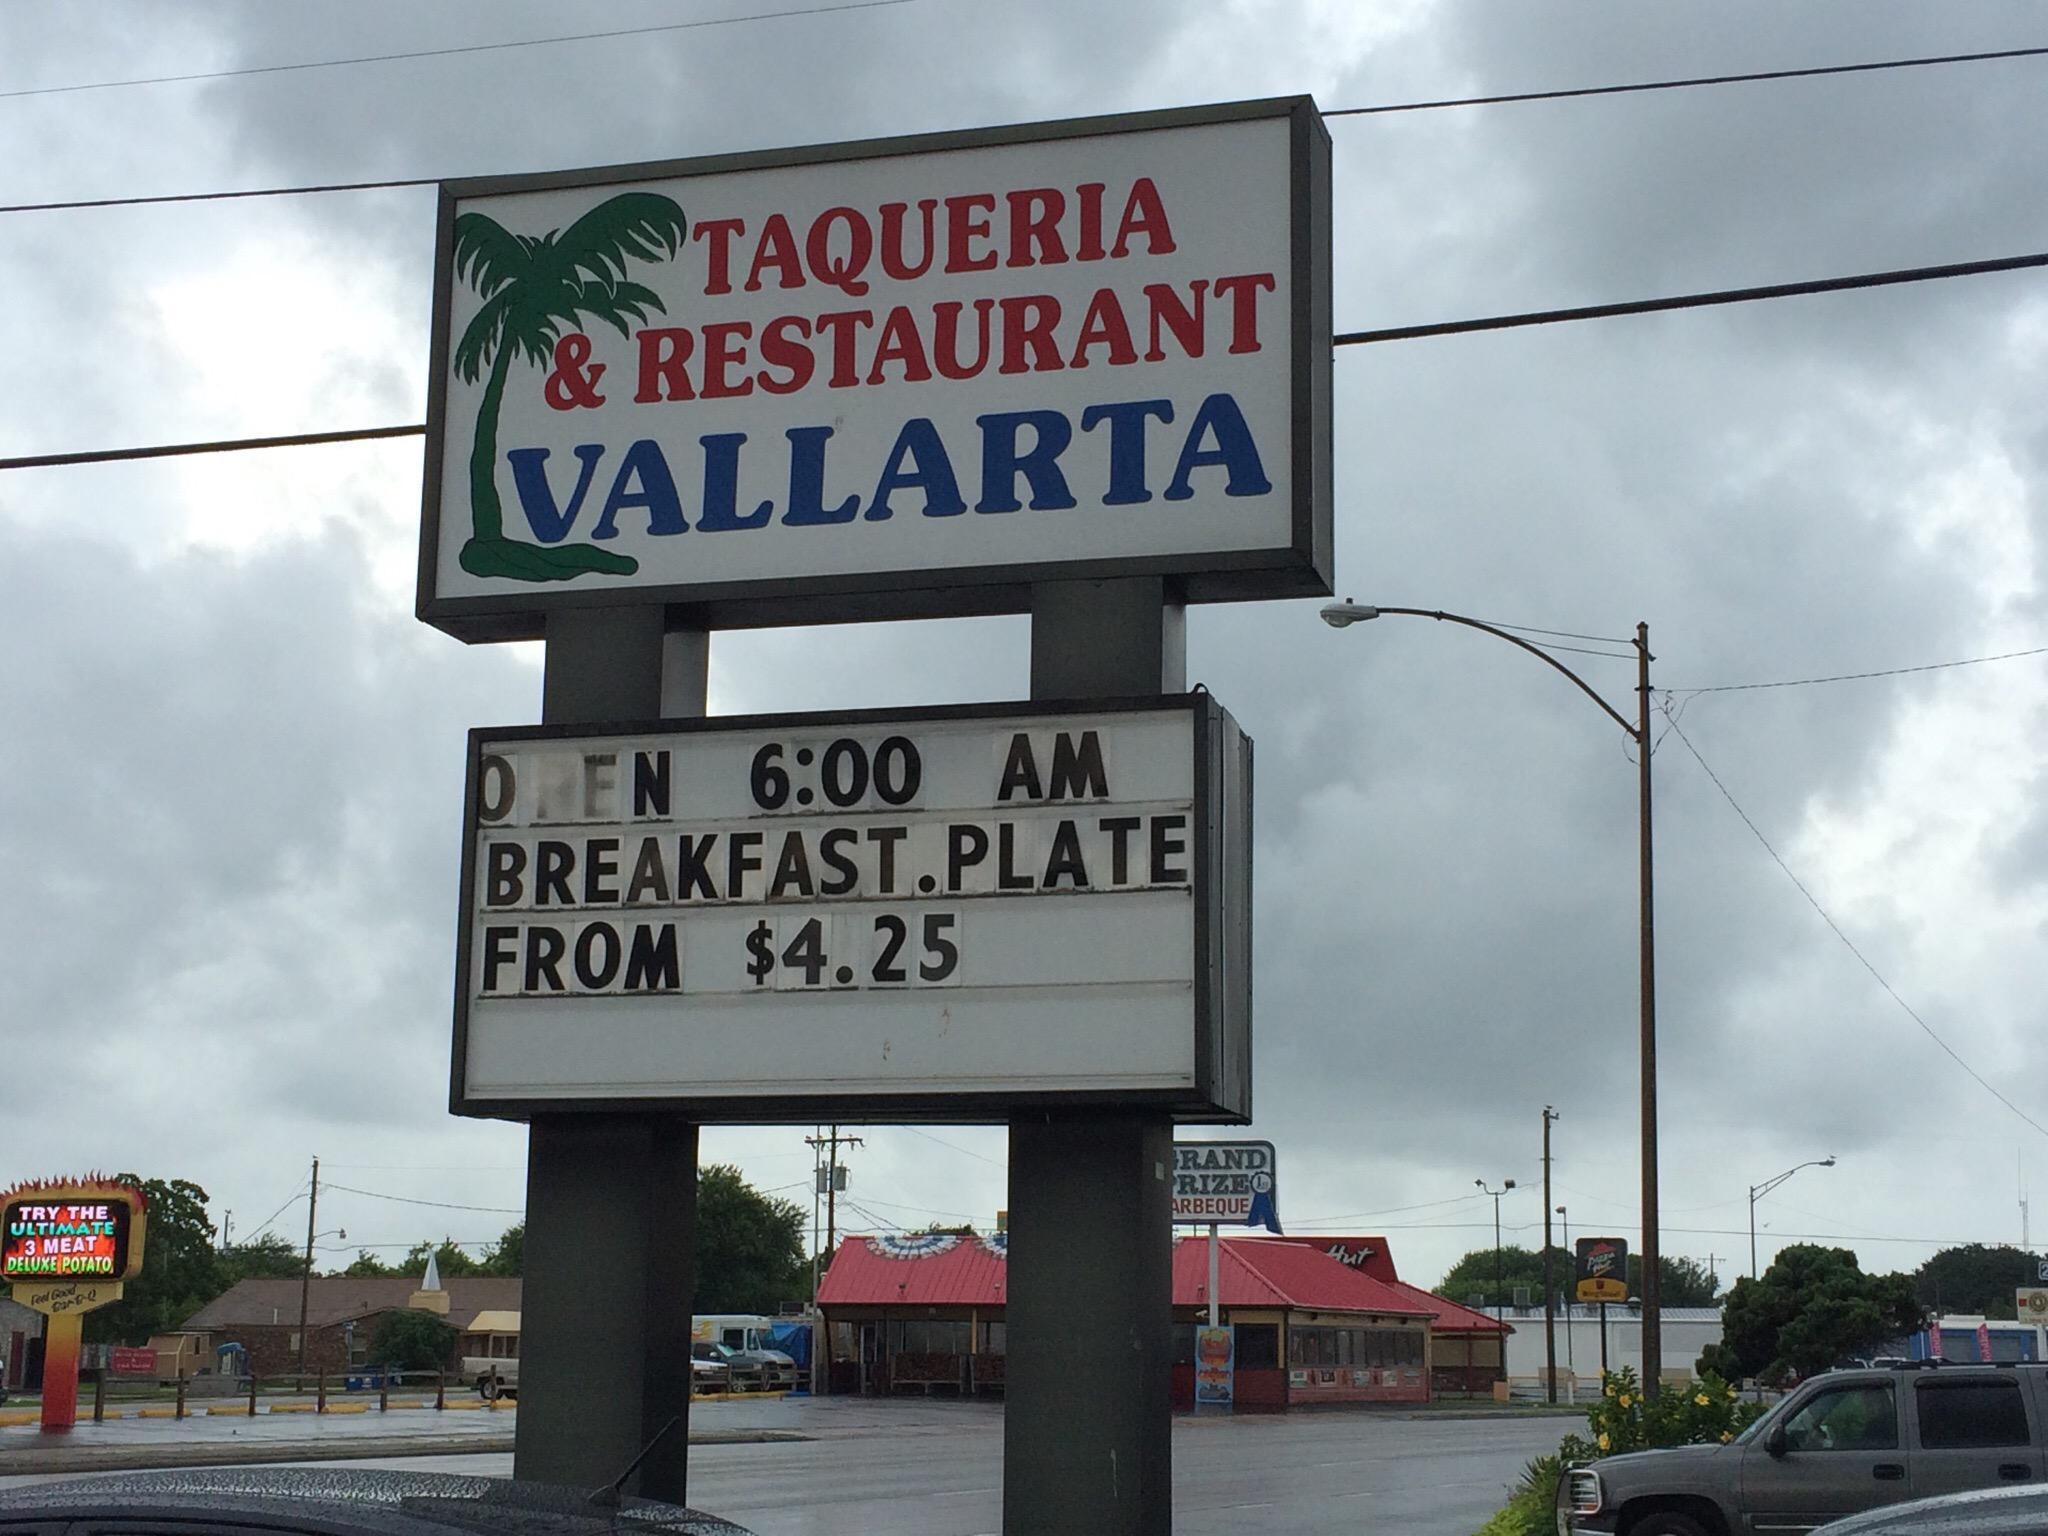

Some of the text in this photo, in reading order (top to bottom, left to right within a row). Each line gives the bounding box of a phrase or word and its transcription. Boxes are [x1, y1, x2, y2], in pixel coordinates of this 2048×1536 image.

[693, 176, 1177, 297] TAQUERIA
[543, 272, 1277, 412] & RESTAURANT
[506, 393, 1273, 545] VALLARTA
[481, 729, 1109, 824] OEN 6:00 AM
[483, 912, 959, 994] FROM $4.25
[1172, 1173, 1249, 1195] RIZE
[10, 1221, 115, 1236] ULTIMATE
[19, 1205, 108, 1220] TRY THE
[7, 1256, 112, 1272] DELUXE POTATO
[25, 1235, 97, 1256] 3 MEAT
